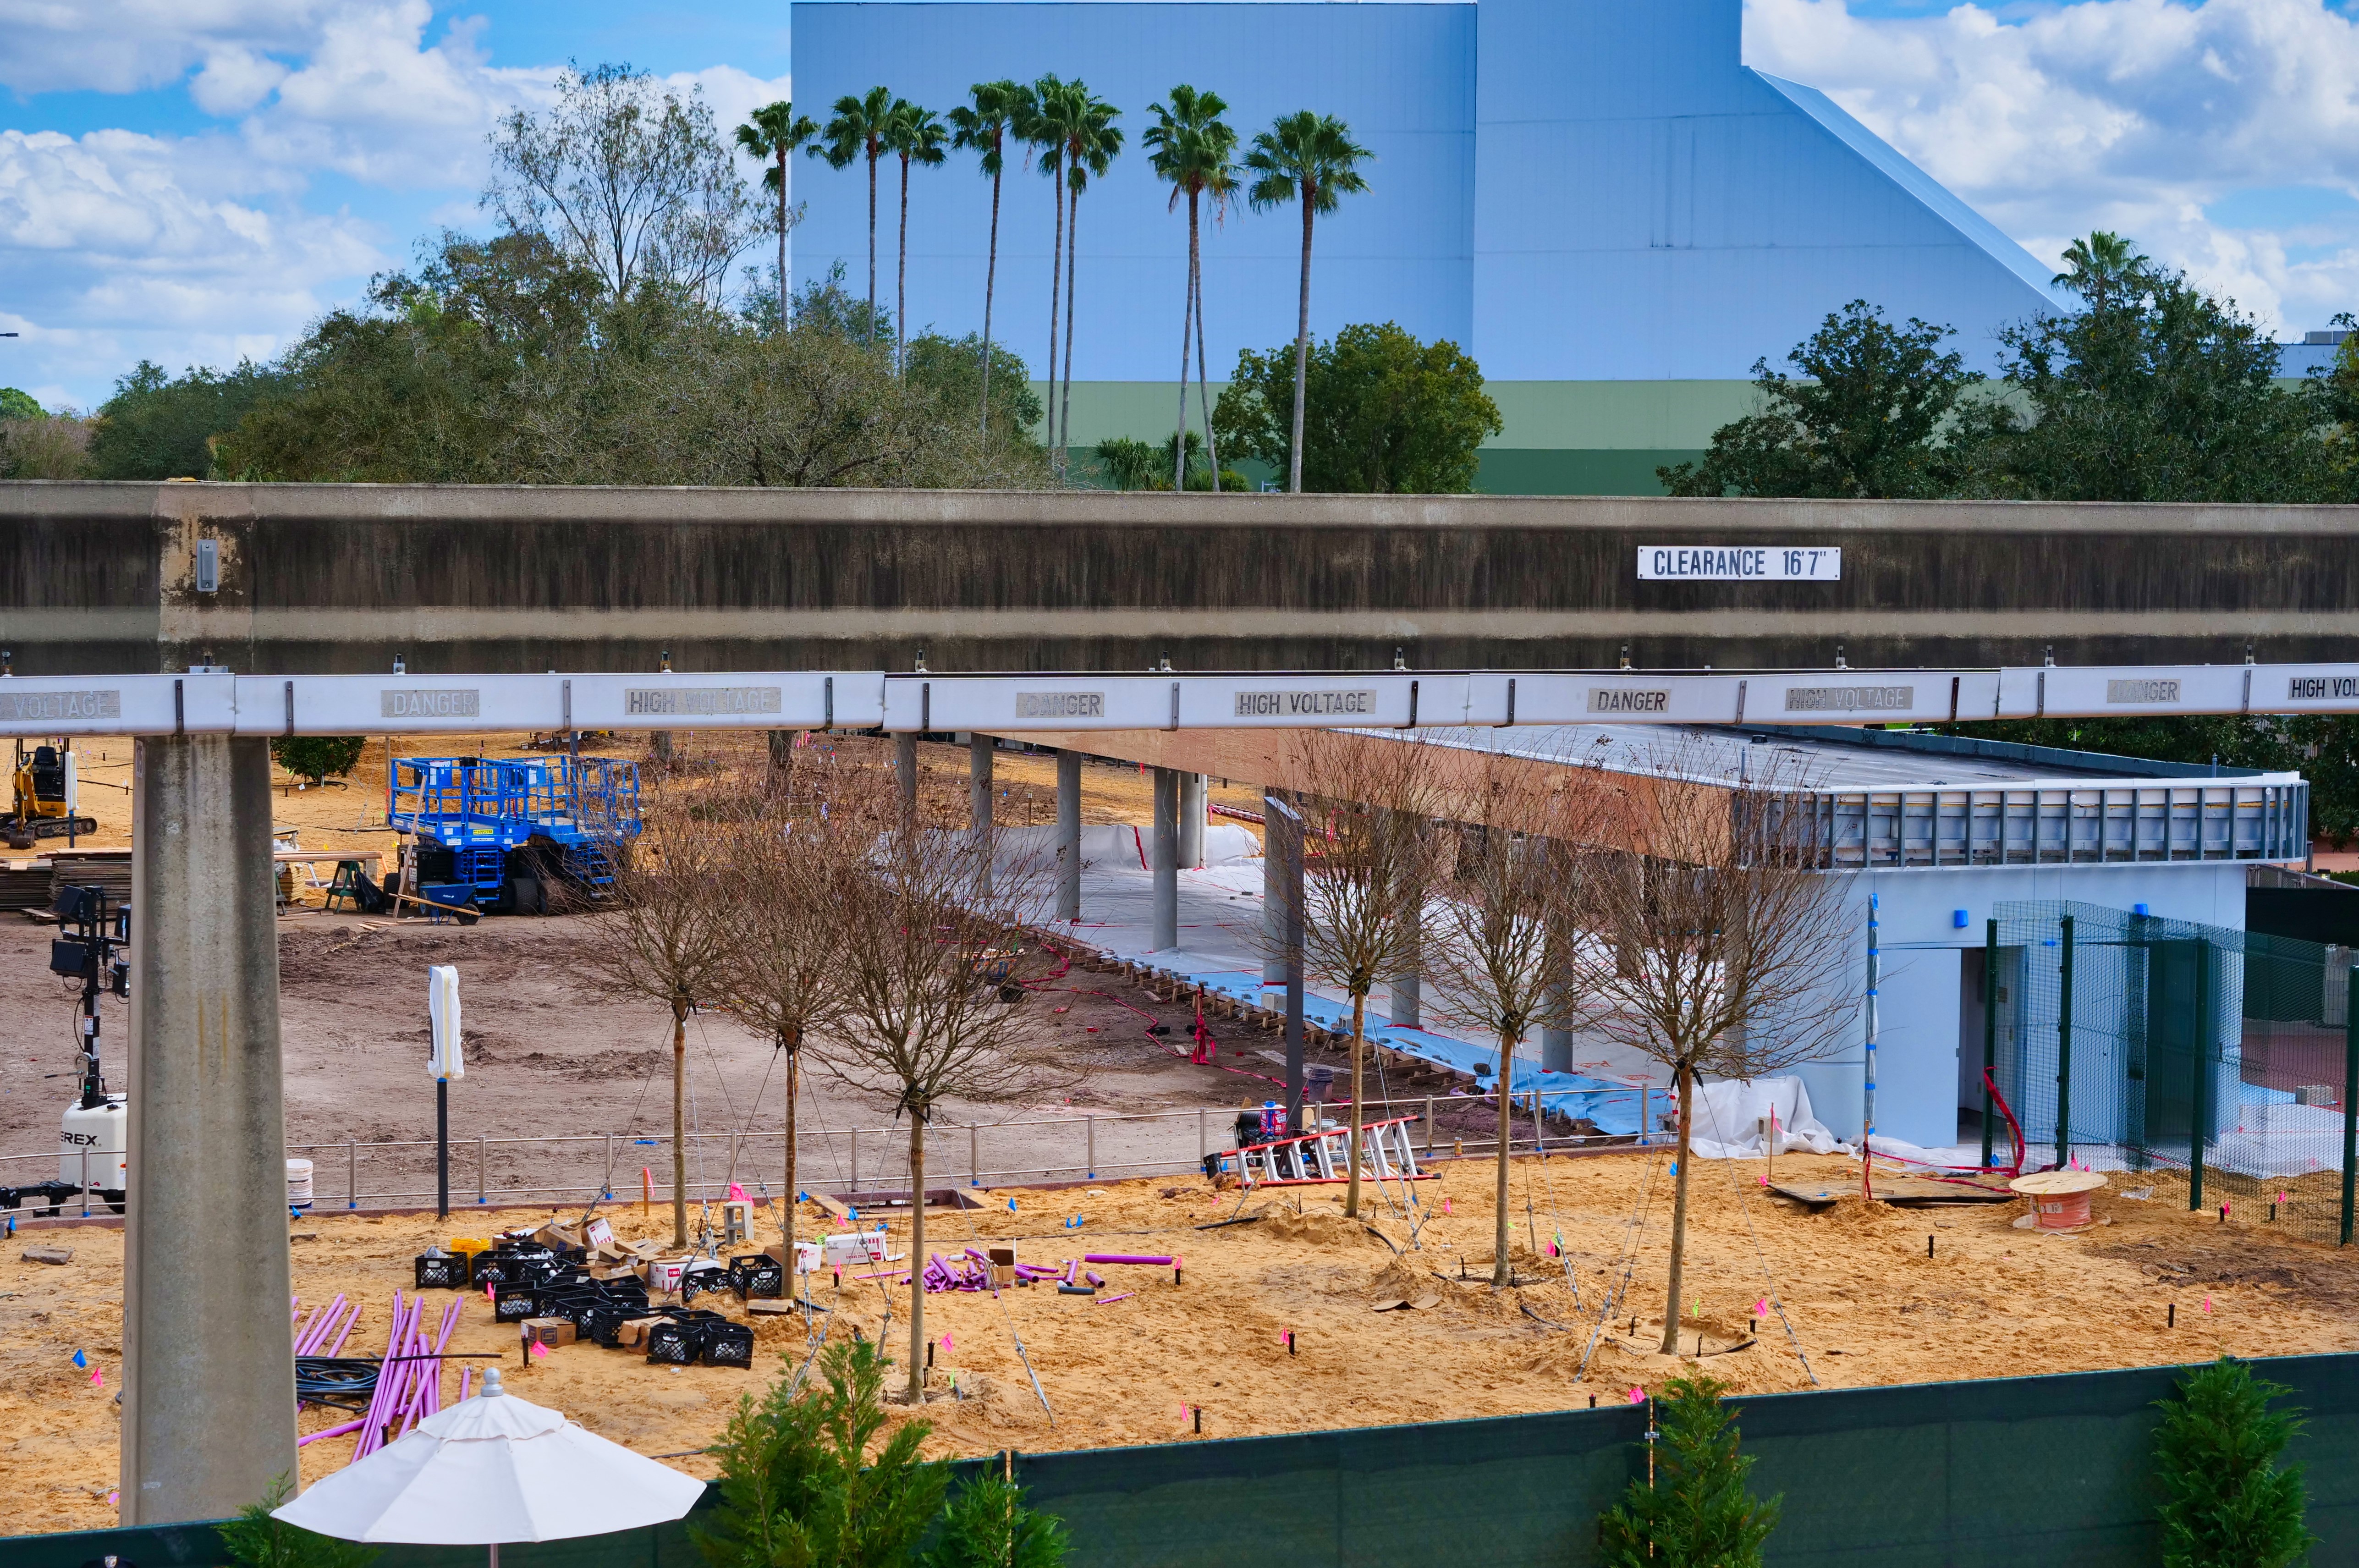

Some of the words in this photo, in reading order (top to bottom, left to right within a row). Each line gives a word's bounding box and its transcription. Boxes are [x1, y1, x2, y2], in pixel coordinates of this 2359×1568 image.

[1654, 550, 1765, 575] CLEARANCE
[1790, 690, 1826, 708] HIGH
[1836, 689, 1905, 708] VOLTAGE
[2292, 679, 2326, 698] HIGH
[13, 694, 110, 718] VOLTAGE
[394, 693, 474, 715] DANGER
[630, 692, 675, 713] HIGH
[686, 690, 770, 711] VOLTAGE
[1027, 695, 1100, 716] DANGER
[1240, 694, 1281, 714] HIGH
[1290, 693, 1367, 713] VOLTAGE
[1597, 691, 1666, 711] DANGER
